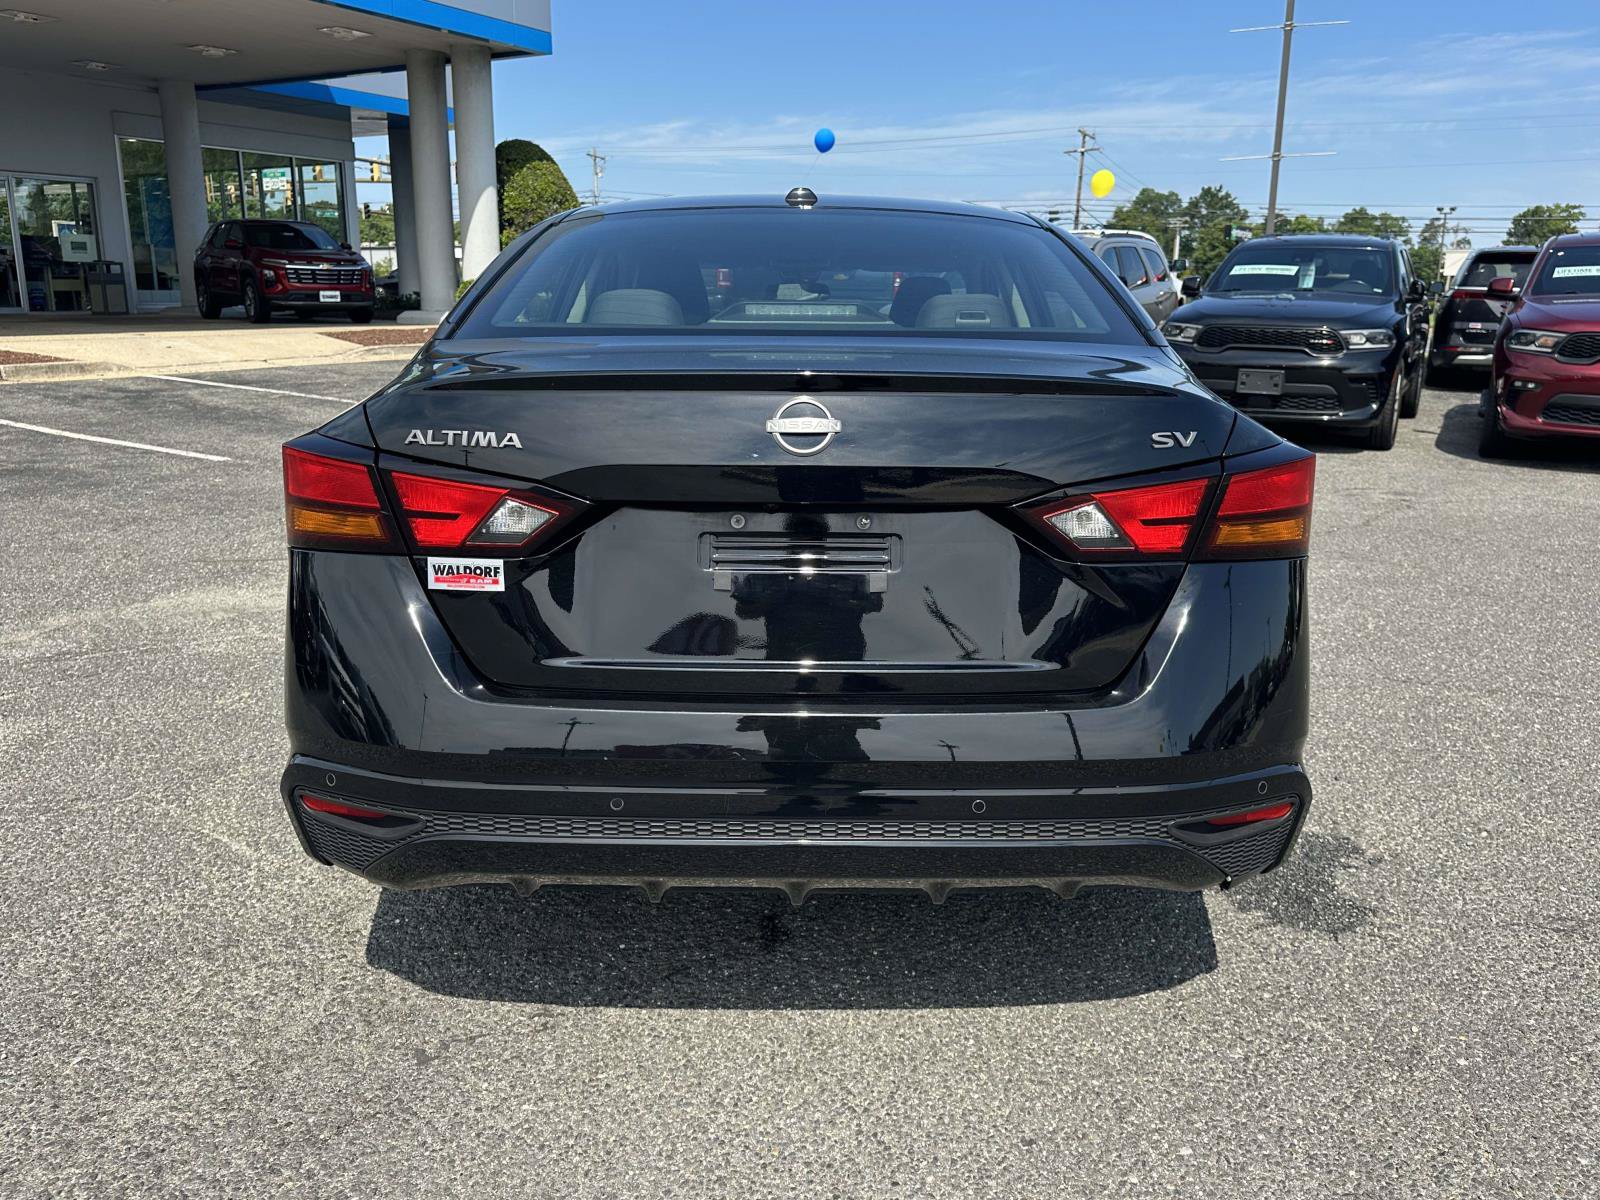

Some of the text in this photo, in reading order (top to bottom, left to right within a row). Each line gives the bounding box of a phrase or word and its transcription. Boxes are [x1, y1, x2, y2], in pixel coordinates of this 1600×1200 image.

[766, 420, 841, 431] NISSAN
[404, 429, 523, 449] ALTIMA
[1151, 431, 1198, 448] SV
[432, 564, 501, 578] WALDORF
